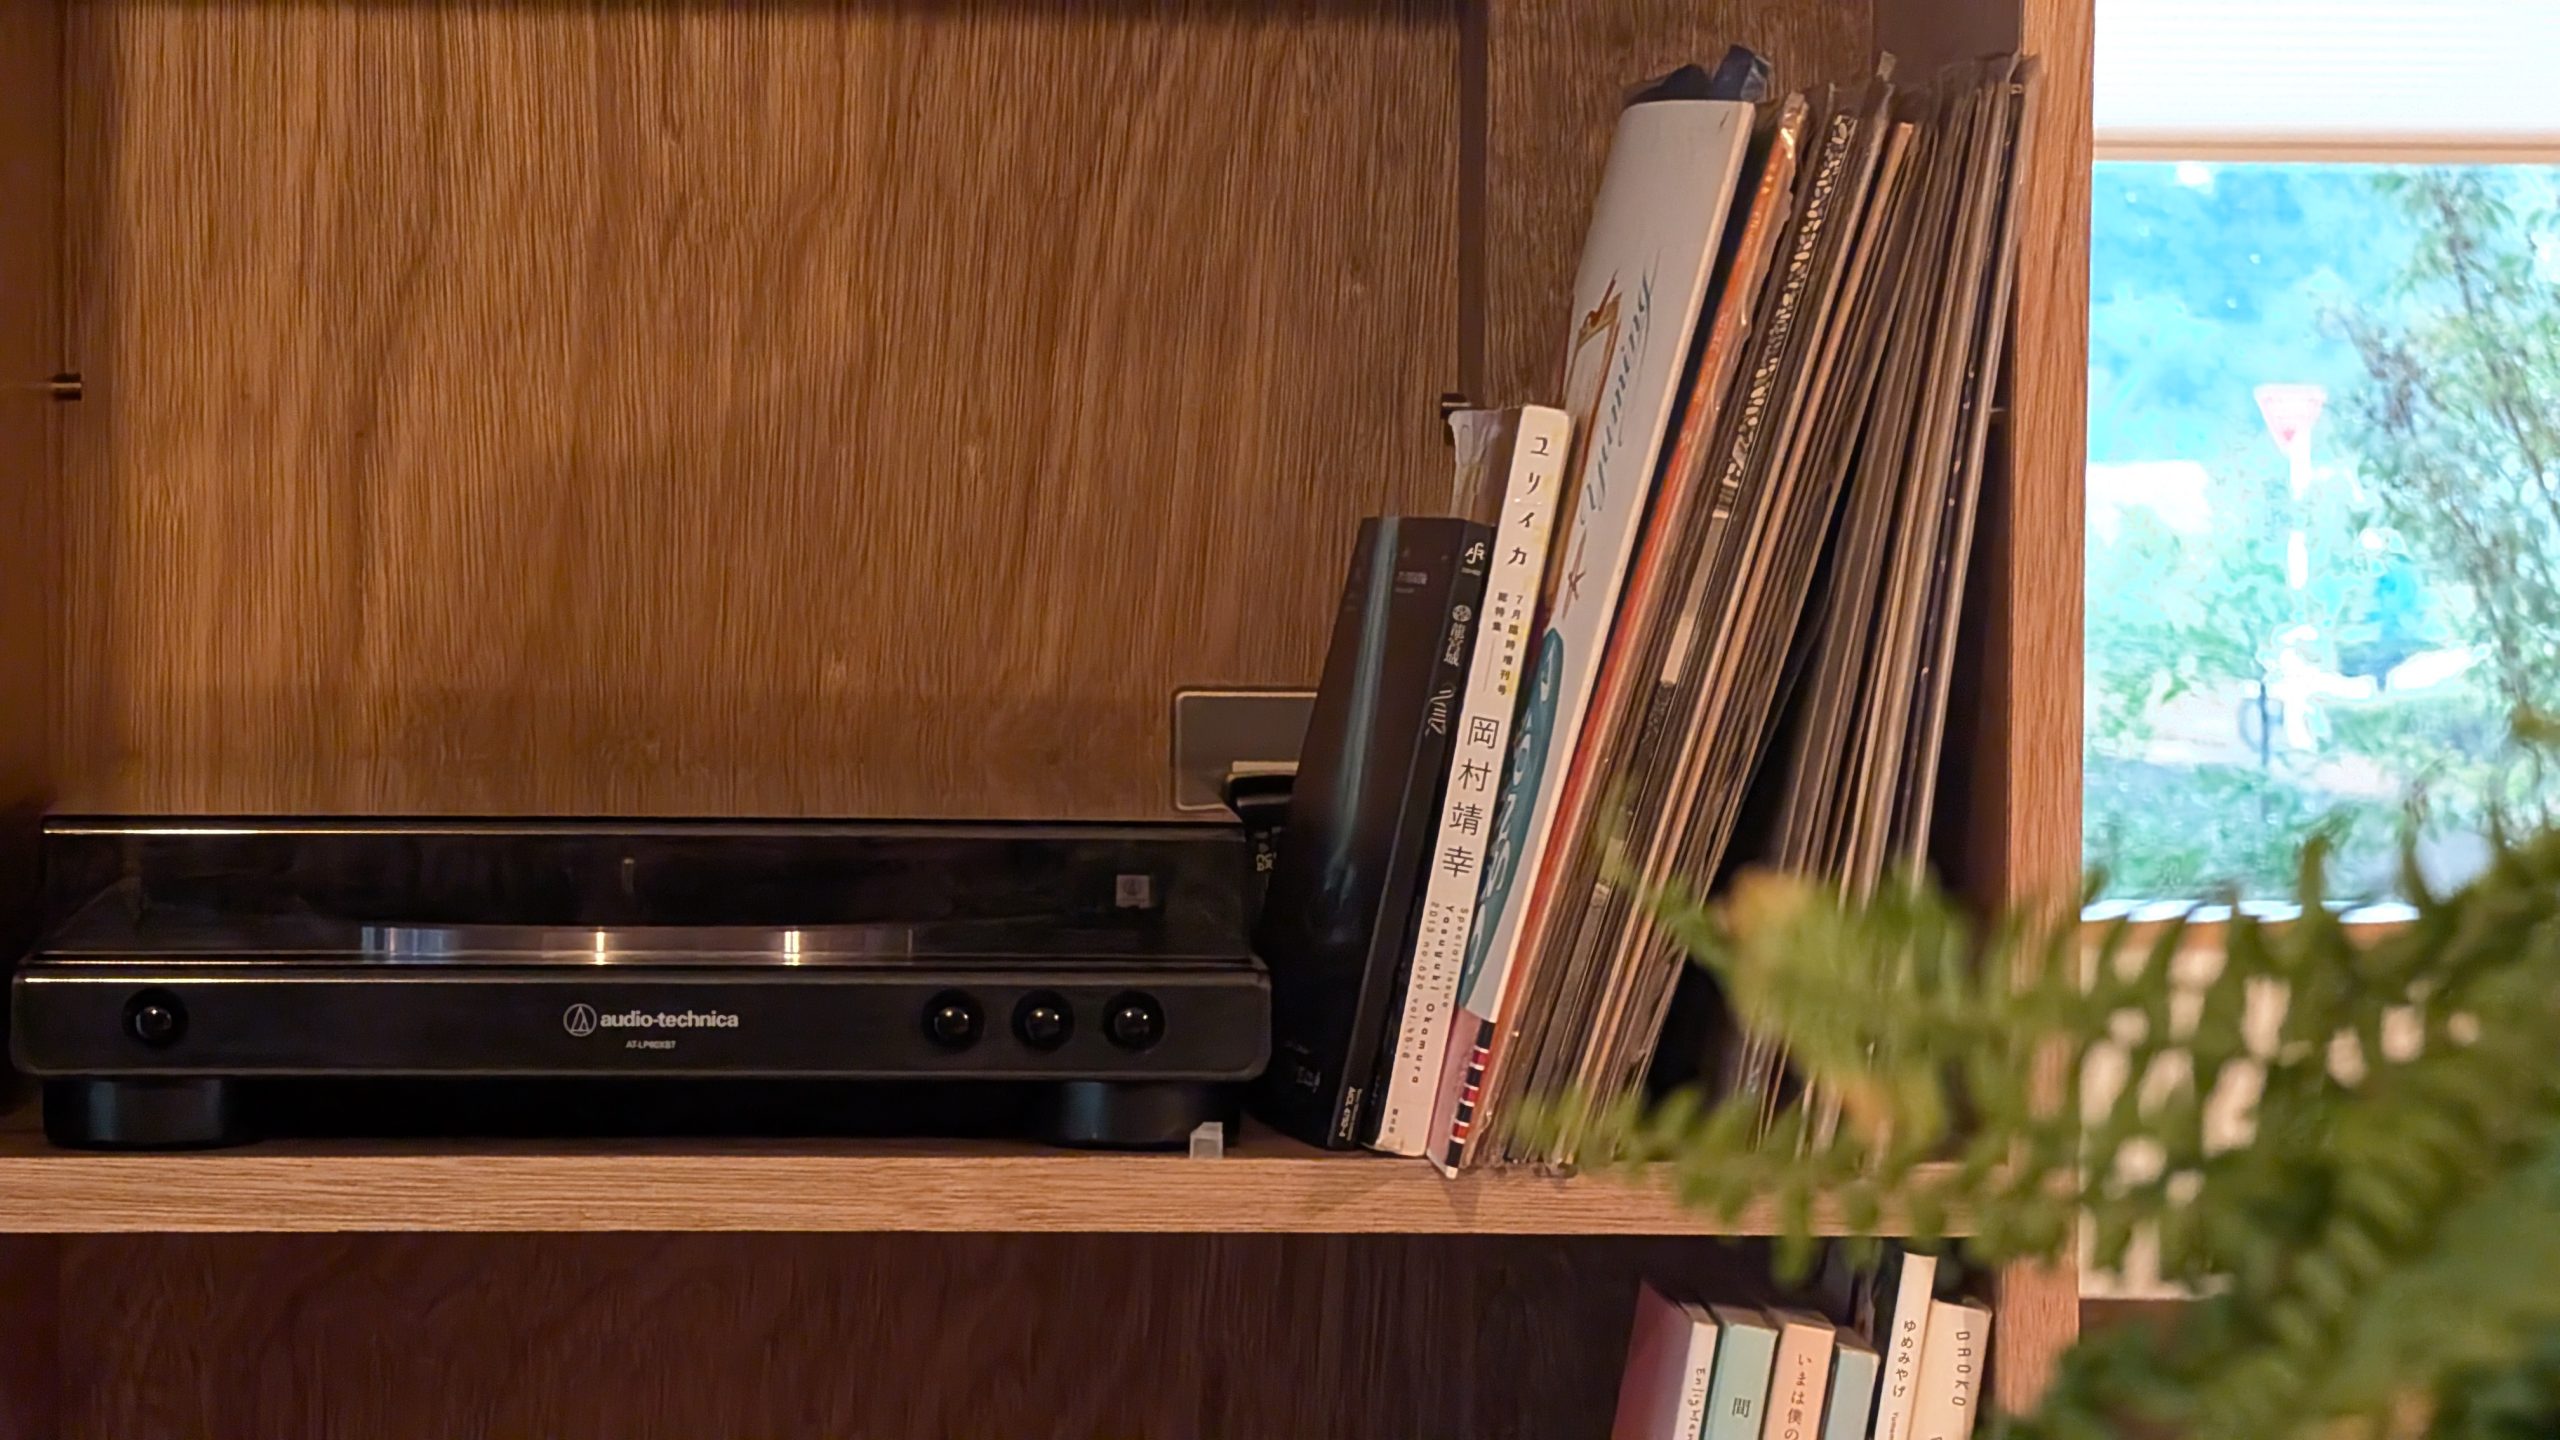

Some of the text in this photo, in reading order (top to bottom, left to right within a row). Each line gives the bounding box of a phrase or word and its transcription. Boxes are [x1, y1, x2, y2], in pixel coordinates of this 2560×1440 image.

[1506, 436, 1550, 566] ユリイカ
[1442, 715, 1500, 878] 岡村靖幸
[600, 1010, 739, 1028] audio-technica
[1411, 1003, 1435, 1083] Okamura
[1784, 1353, 1812, 1440] いまは僕の
[1893, 1320, 1916, 1398] ゆめみやげ
[1951, 1331, 1971, 1407] DAOKO
[1732, 1397, 1751, 1418] 間
